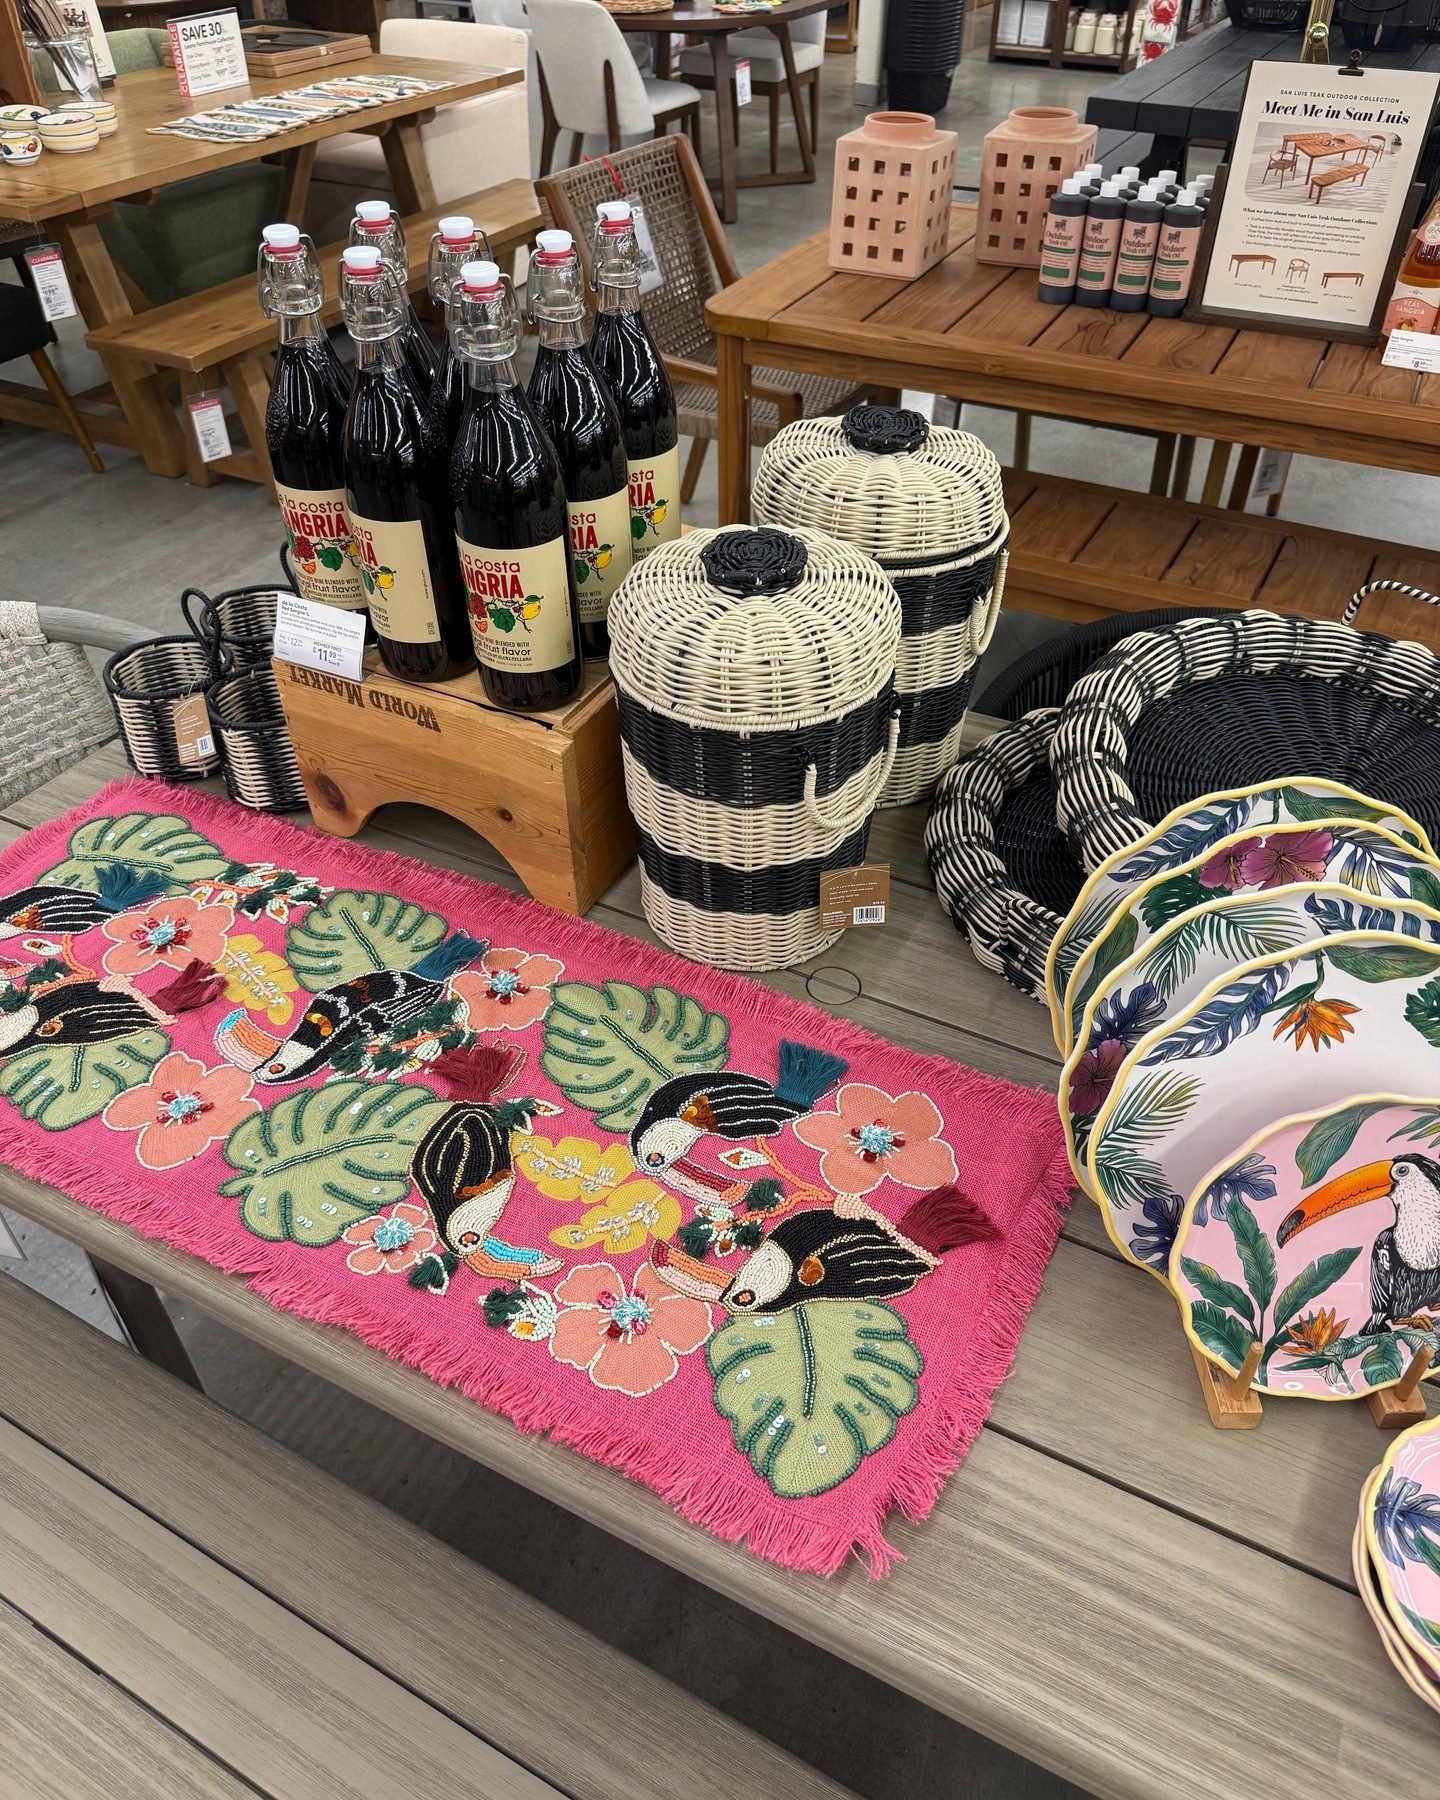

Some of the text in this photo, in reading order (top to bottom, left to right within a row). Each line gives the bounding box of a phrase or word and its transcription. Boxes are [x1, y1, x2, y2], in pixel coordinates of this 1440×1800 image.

[182, 24, 208, 42] SAVE
[208, 21, 222, 36] 30
[169, 24, 189, 94] CLEARANCE
[1326, 93, 1358, 101] OUTDOOR
[1359, 95, 1400, 104] COLLECTION
[1262, 100, 1411, 125] Meet Me in San Luis
[1046, 230, 1074, 242] Outdoor
[1123, 238, 1152, 248] Outdoor
[1160, 242, 1187, 252] Outdoor
[32, 254, 58, 264] CLEARANCE
[1396, 305, 1425, 315] SANGRIA
[285, 495, 344, 513] la costa
[283, 506, 350, 537] ANGRIA
[462, 549, 520, 573] la costa
[312, 583, 330, 592] fruit
[290, 607, 306, 615] Sangria
[484, 641, 531, 655] fruit flavor
[290, 665, 441, 733] WORLD MARKET
